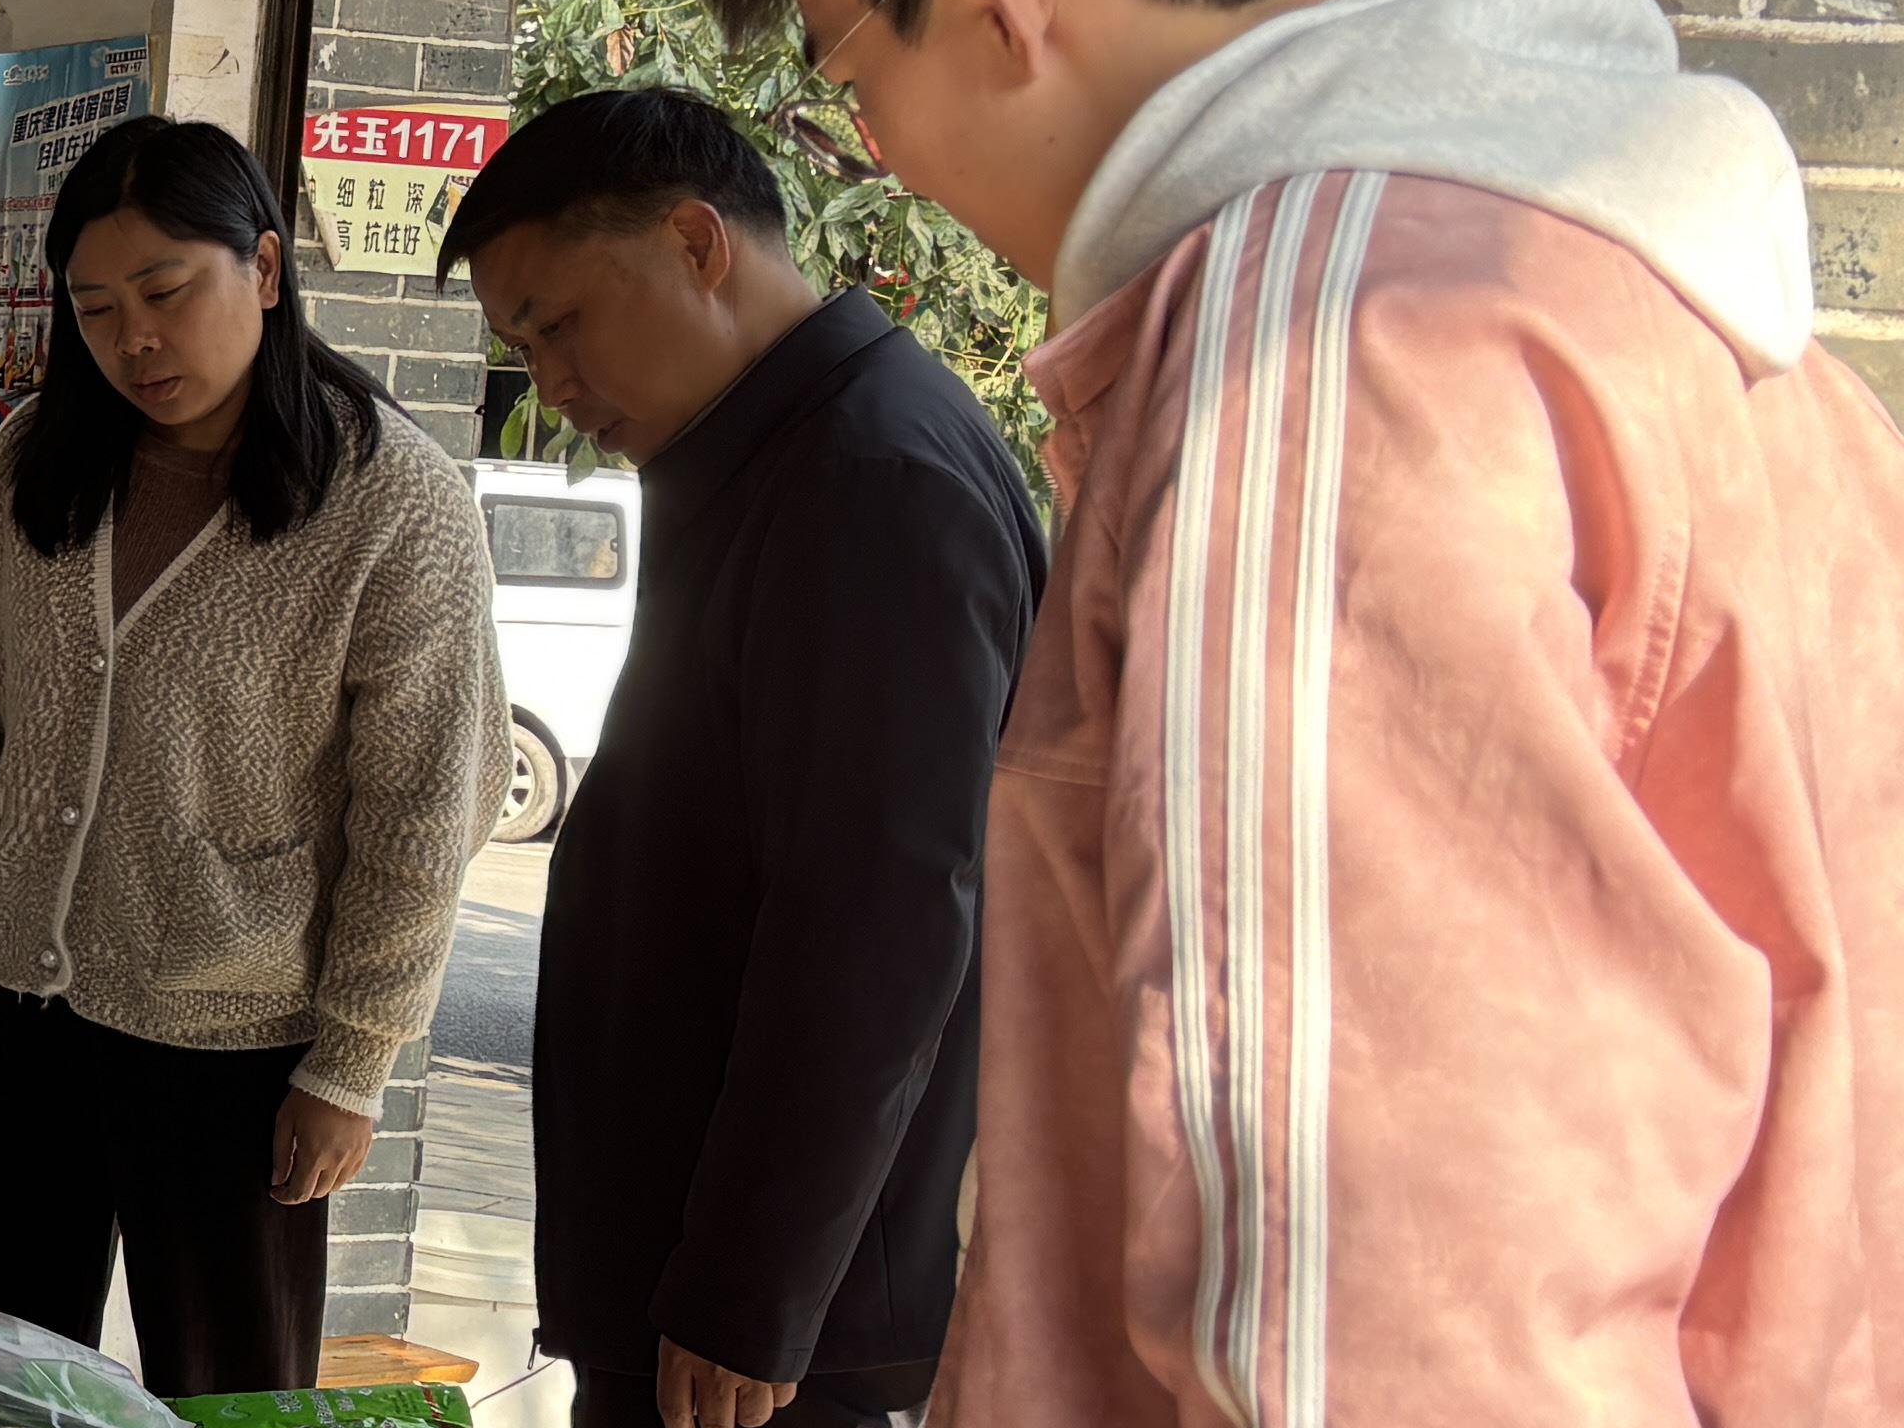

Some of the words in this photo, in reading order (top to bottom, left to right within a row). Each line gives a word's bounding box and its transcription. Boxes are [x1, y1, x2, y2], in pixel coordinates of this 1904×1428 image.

[311, 111, 486, 165] 先玉1171
[363, 221, 422, 256] 抗性好
